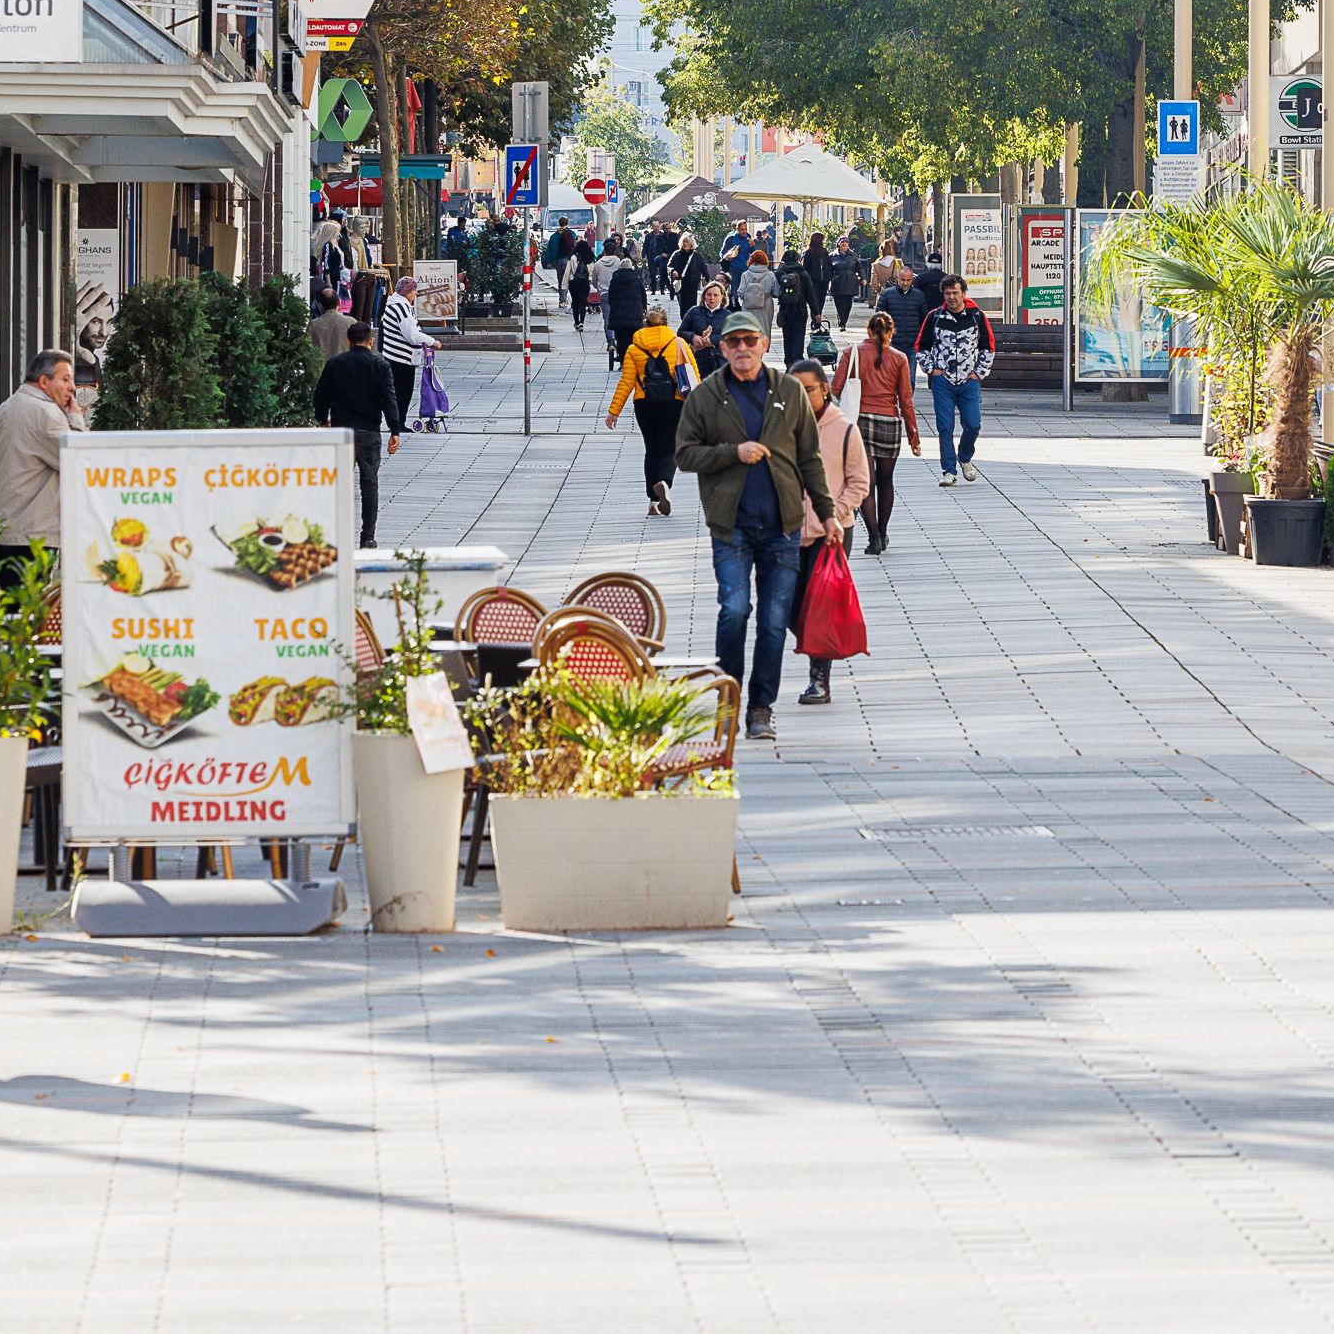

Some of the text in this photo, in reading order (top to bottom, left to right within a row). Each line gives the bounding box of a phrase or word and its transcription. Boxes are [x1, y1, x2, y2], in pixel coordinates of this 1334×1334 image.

[1281, 136, 1301, 144] Bowl
[1042, 228, 1064, 237] SP
[417, 275, 453, 284] Aktion!
[85, 468, 178, 488] WRAPS
[120, 492, 173, 505] VEGAN
[112, 618, 327, 640] SUSHI TACO
[138, 645, 329, 658] VEGAN VEGAN
[151, 801, 286, 822] MEIDLING
